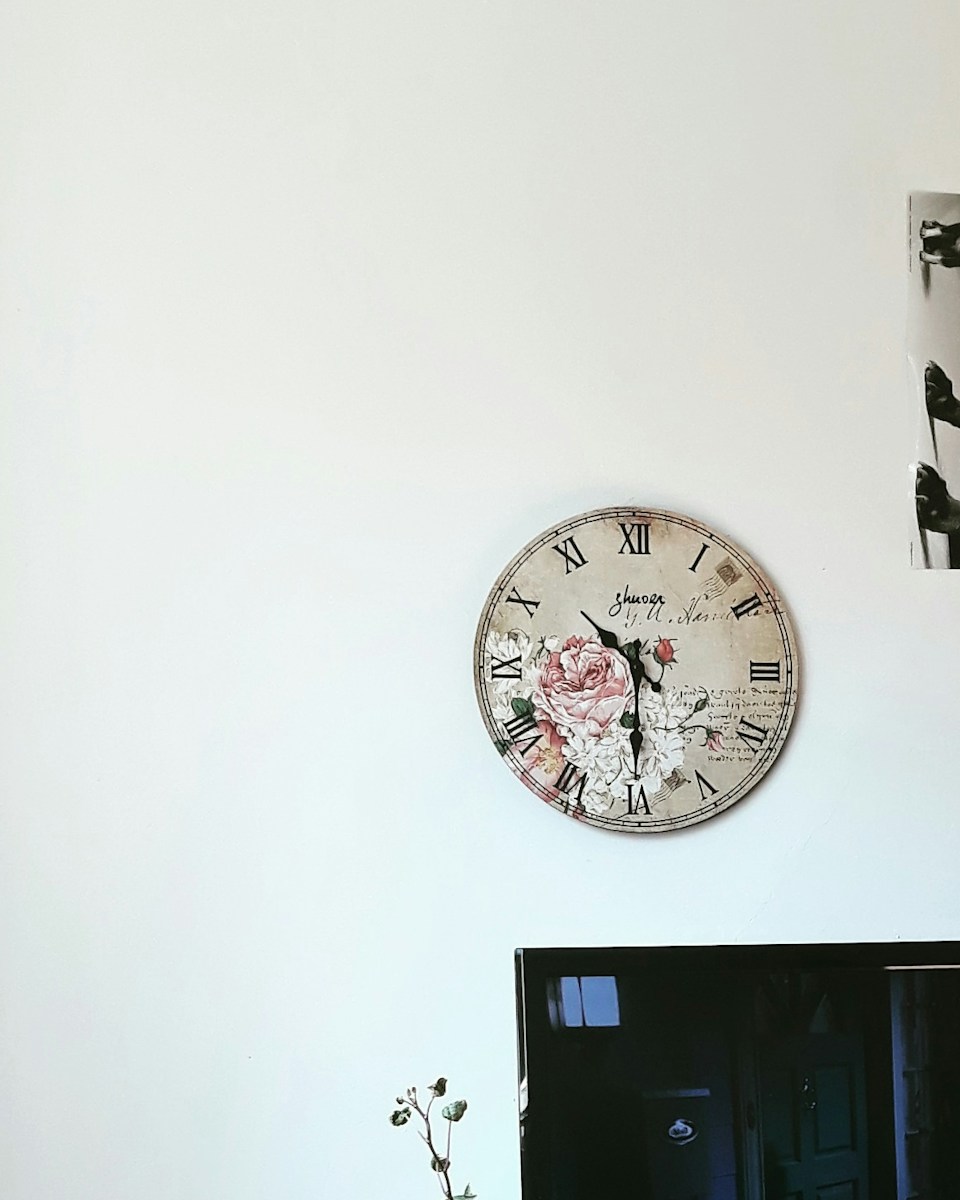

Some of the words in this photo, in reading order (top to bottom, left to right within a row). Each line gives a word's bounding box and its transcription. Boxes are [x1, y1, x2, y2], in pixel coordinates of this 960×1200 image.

[618, 523, 651, 554] XII
[552, 536, 589, 575] XI
[688, 543, 710, 573] I
[506, 586, 540, 619] X
[730, 592, 763, 620] II
[491, 655, 522, 681] IX
[750, 660, 780, 683] III
[502, 714, 545, 758] VIII
[736, 717, 769, 755] IV
[552, 761, 590, 803] VII
[694, 769, 720, 801] V
[626, 784, 653, 816] VI
